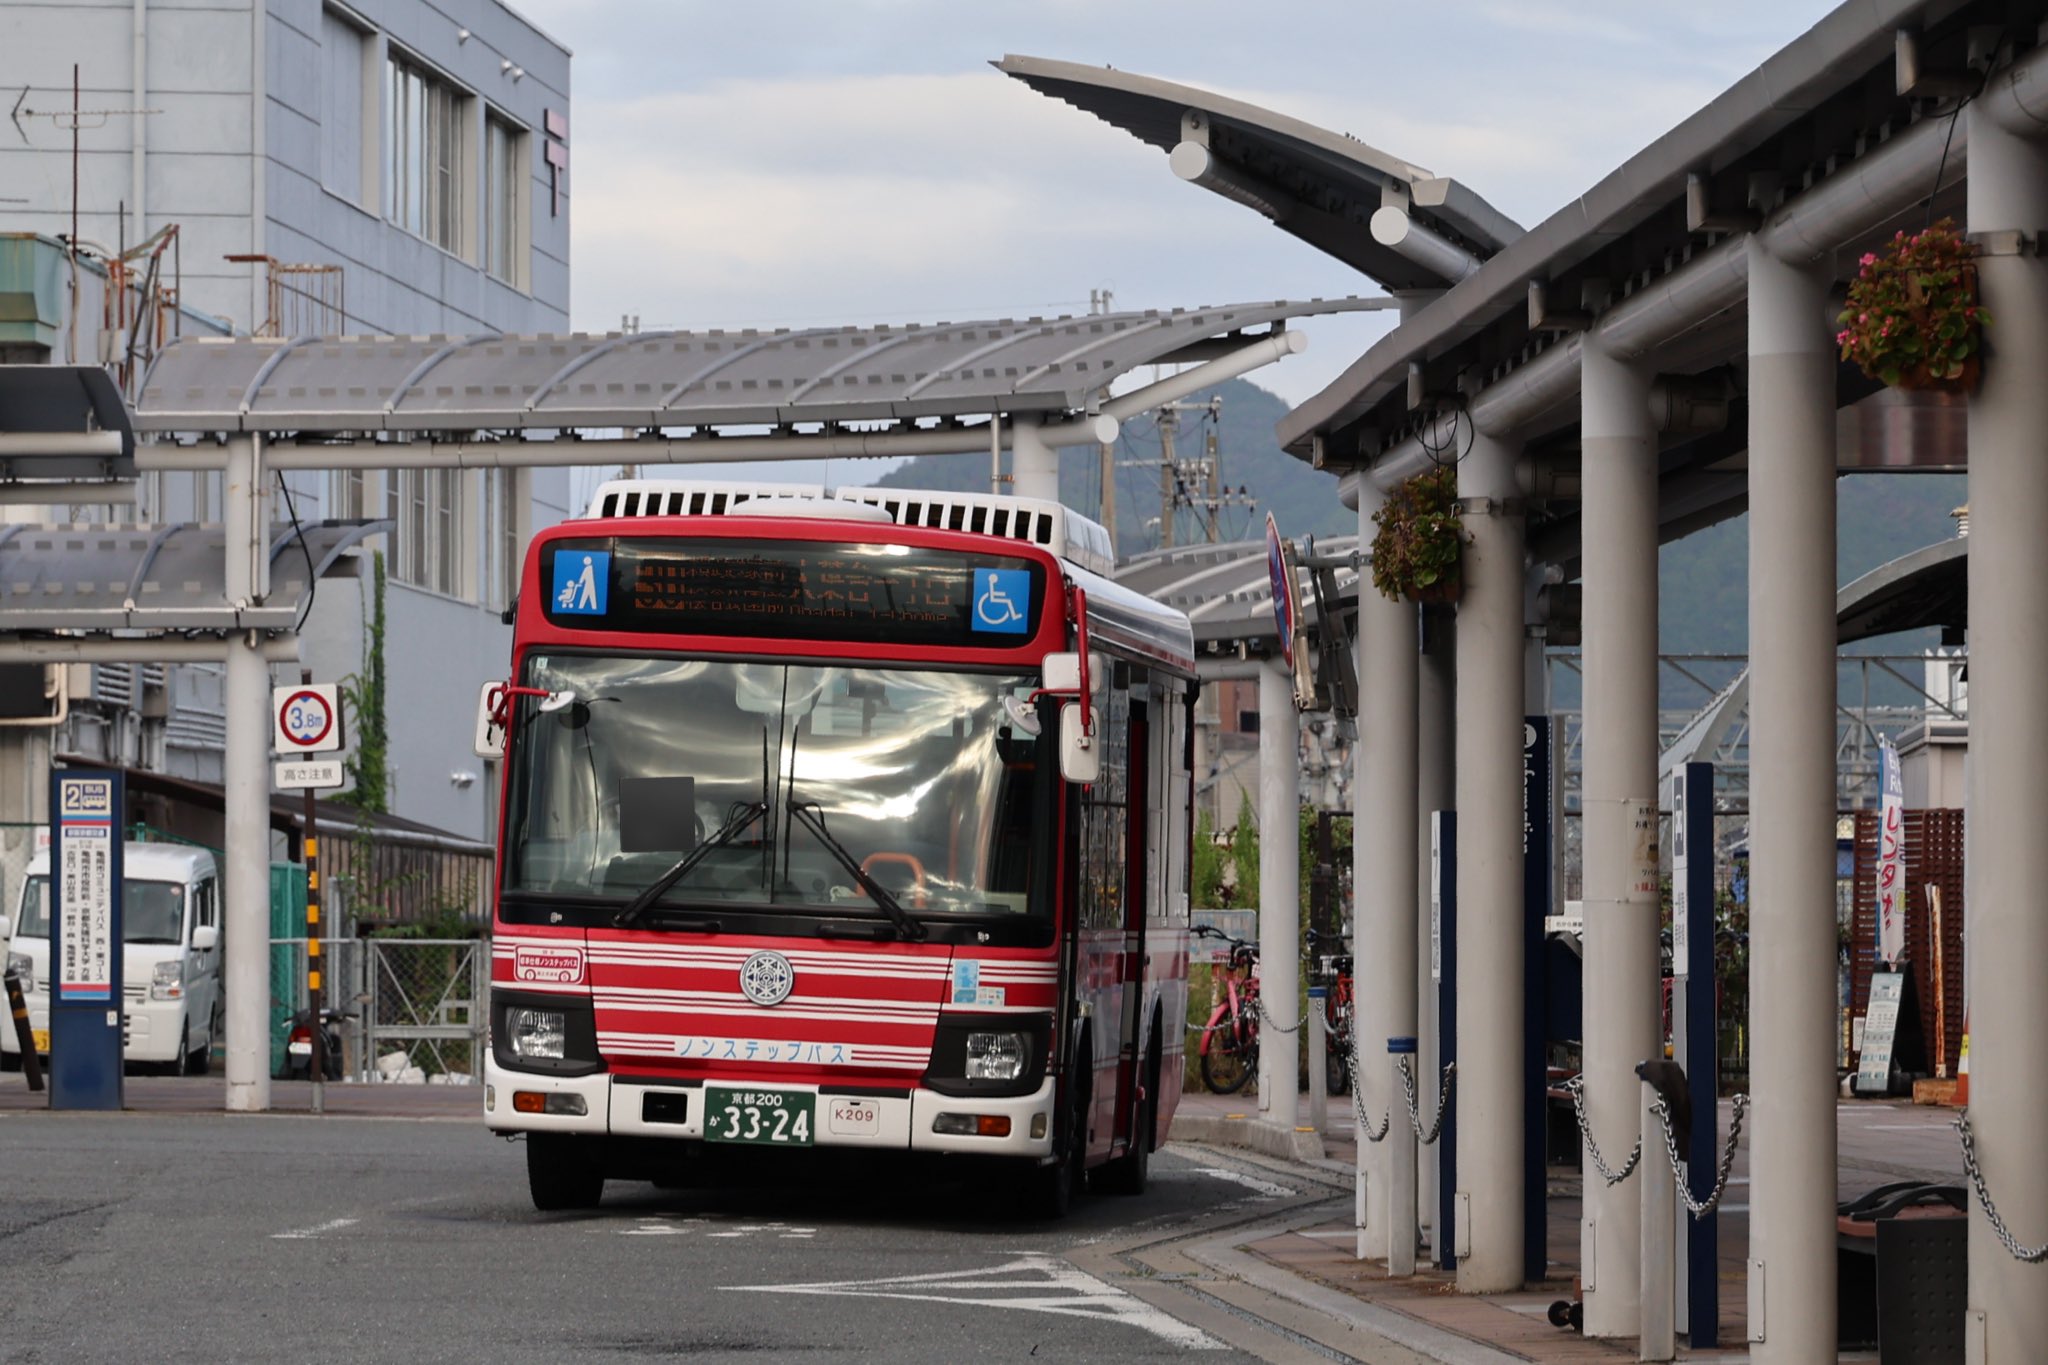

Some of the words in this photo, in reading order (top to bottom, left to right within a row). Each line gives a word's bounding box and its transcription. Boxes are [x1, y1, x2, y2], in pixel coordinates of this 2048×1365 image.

[290, 706, 323, 730] 3.8m
[284, 767, 333, 781] 高さ注意
[66, 785, 80, 809] 2
[84, 784, 105, 795] BUS
[680, 1038, 845, 1064] ノンステップバス
[709, 1115, 721, 1127] か
[723, 1106, 809, 1142] 33-24
[834, 1109, 874, 1122] K209
